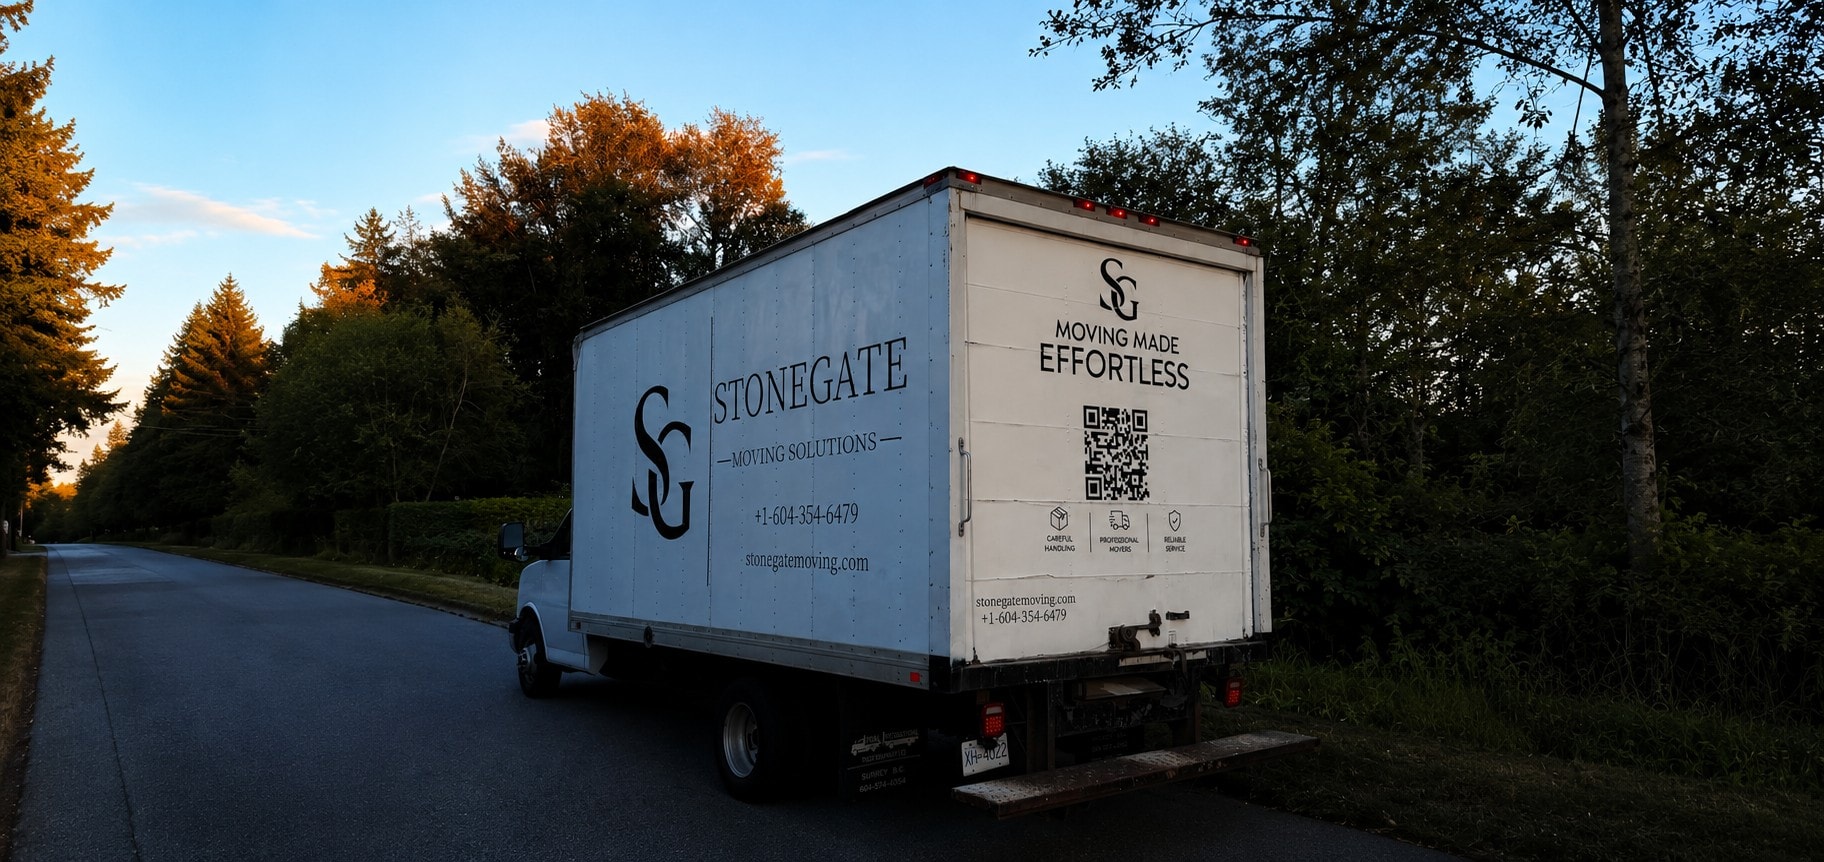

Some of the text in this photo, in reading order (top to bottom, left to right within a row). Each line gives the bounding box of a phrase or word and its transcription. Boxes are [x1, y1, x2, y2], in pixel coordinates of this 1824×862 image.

[1056, 319, 1180, 355] MOVING MADE
[1040, 342, 1190, 390] EFFORTLESS
[714, 336, 908, 424] STONEGATE
[732, 432, 877, 468] MOVING SOLUTIONS
[755, 503, 859, 526] +1-604-354-6479
[1044, 545, 1076, 553] HANDLING
[745, 552, 870, 576] stonegatemoving.com
[976, 594, 1076, 610] stonegatemoving.com
[982, 608, 1067, 625] +1-604-354-6479
